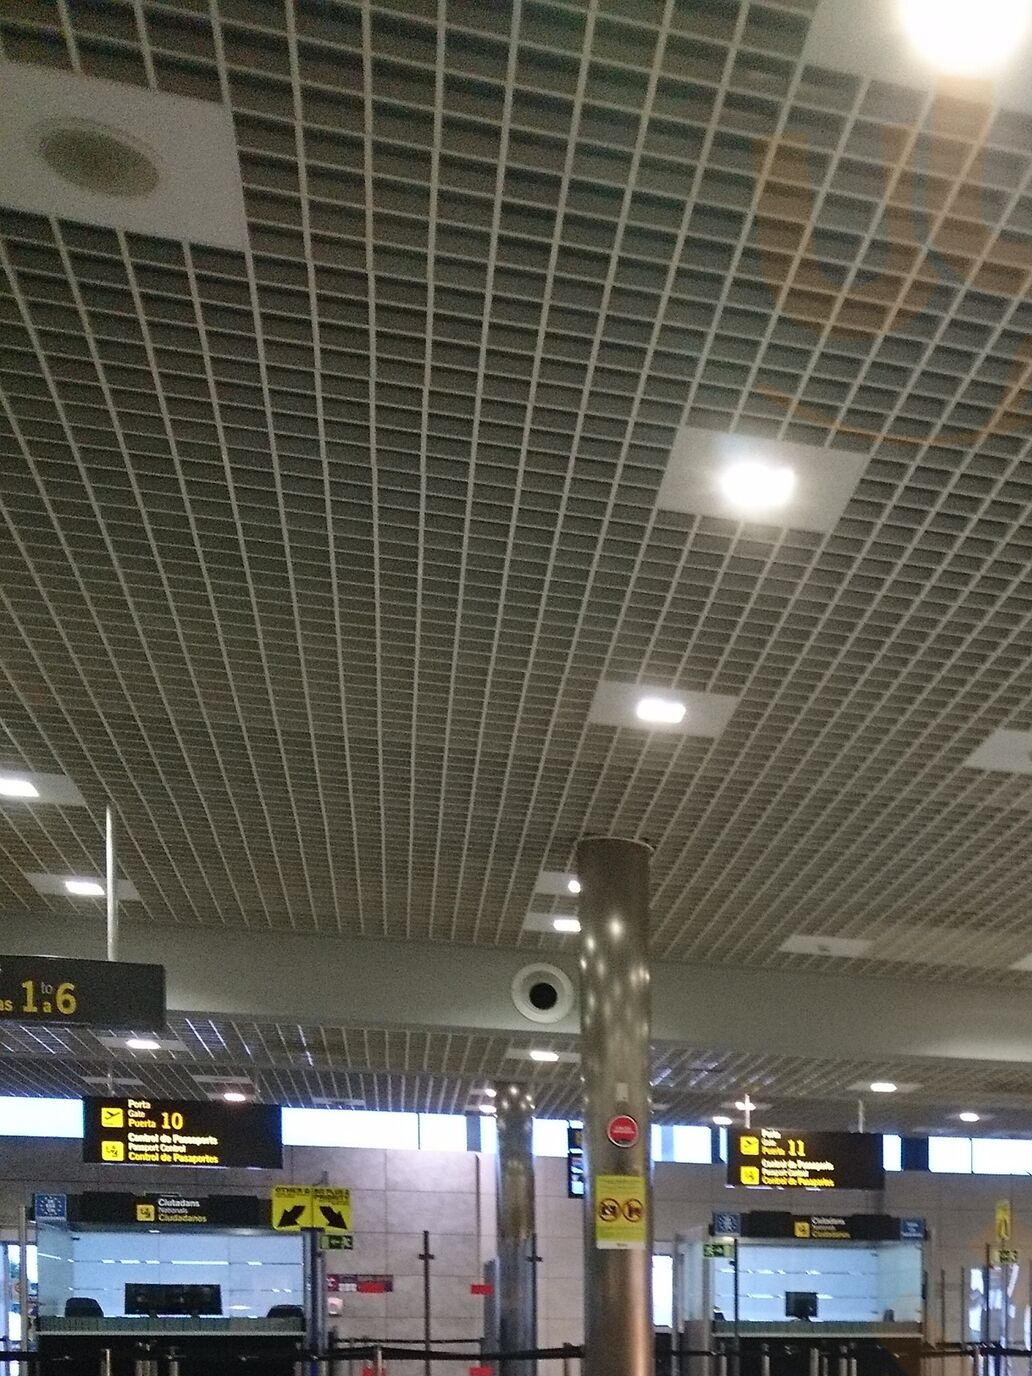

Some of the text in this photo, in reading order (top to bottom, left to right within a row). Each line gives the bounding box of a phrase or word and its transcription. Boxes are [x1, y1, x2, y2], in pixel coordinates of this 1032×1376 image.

[41, 982, 53, 994] to
[21, 980, 38, 1013] 1
[56, 982, 77, 1015] 6
[128, 1112, 183, 1130] Puerta 10
[787, 1139, 806, 1157] 11
[128, 1152, 219, 1164] Control de Pasaportes
[158, 1214, 208, 1223] Ciudadanos
